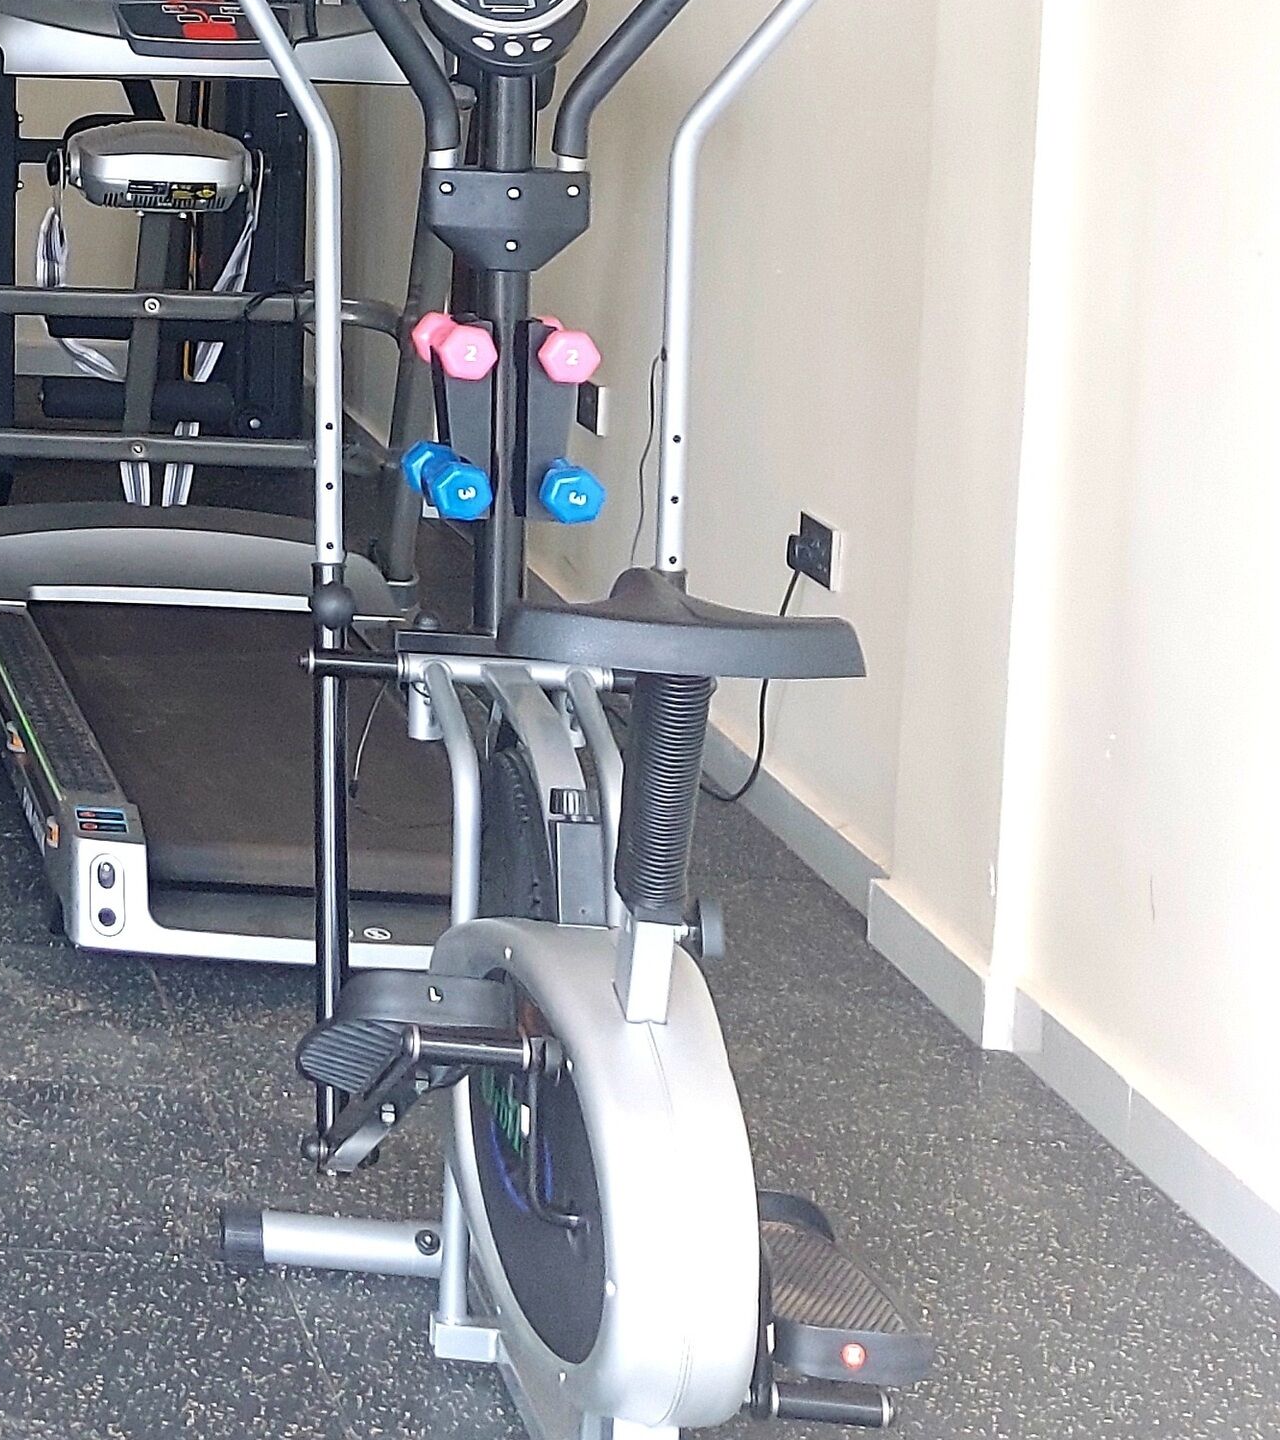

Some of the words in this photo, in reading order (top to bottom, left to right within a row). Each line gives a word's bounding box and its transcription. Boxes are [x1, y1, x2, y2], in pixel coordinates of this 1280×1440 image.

[464, 345, 478, 362] 2
[566, 349, 579, 366] 2
[458, 487, 477, 500] 3
[569, 492, 587, 506] 3
[429, 987, 442, 1002] L
